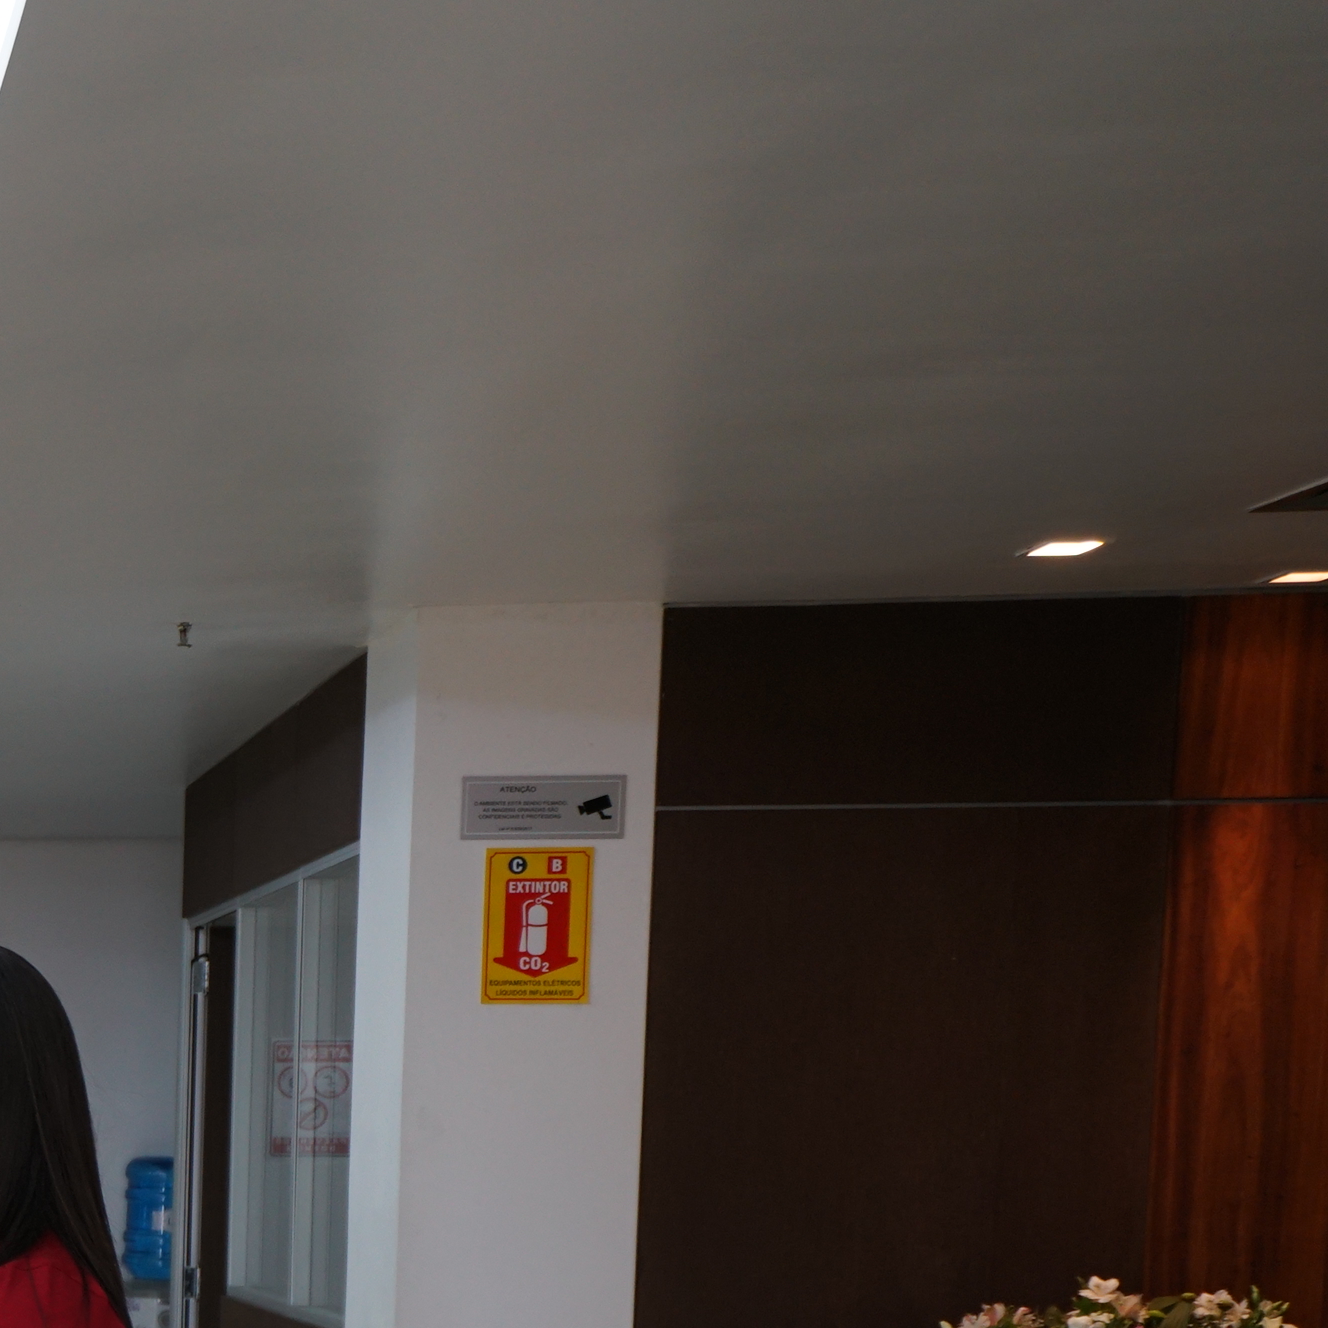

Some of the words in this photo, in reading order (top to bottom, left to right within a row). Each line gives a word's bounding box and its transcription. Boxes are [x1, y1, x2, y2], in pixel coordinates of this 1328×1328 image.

[500, 785, 537, 795] ATENÇÃO
[512, 858, 524, 872] C
[552, 858, 563, 872] B
[508, 881, 569, 894] EXTINTOR
[489, 979, 542, 987] EQUIPAMENTOS
[543, 978, 582, 987] ELÉTRICOS
[495, 988, 528, 997] LÍQUIDOS
[529, 988, 574, 997] INFLAMÁVEIS
